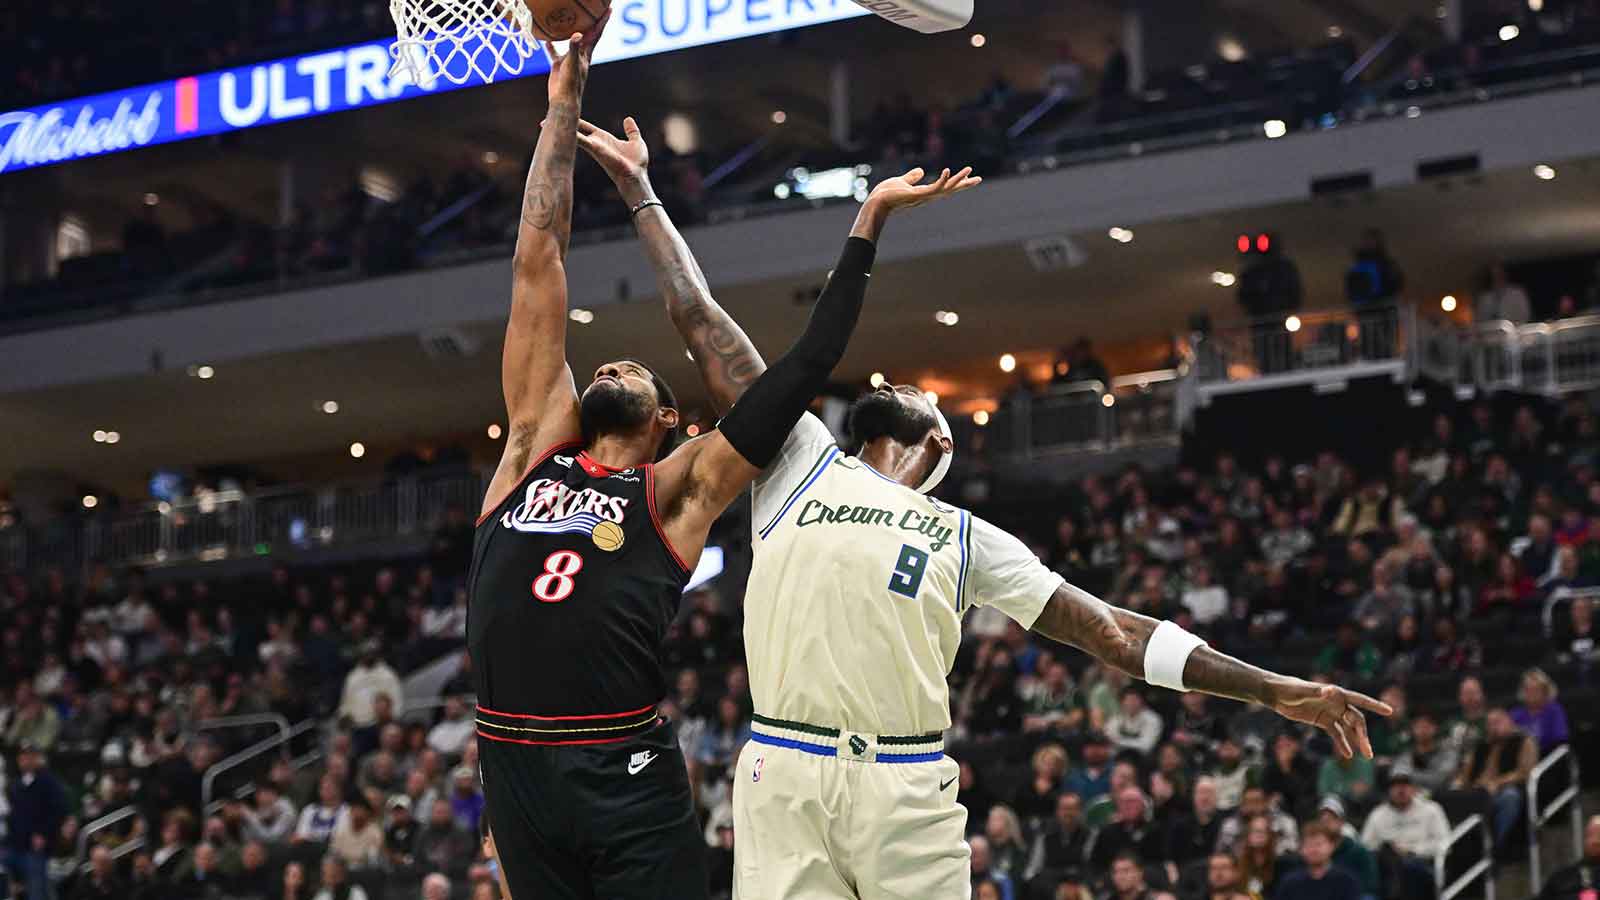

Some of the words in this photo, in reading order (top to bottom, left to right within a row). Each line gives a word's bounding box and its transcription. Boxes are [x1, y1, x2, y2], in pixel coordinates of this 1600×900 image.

[858, 0, 919, 20] OM
[0, 90, 162, 173] Michelob
[219, 44, 437, 127] ULTRA
[796, 499, 893, 527] Cream
[898, 509, 952, 553] City
[531, 550, 584, 602] 8
[888, 543, 929, 599] 9
